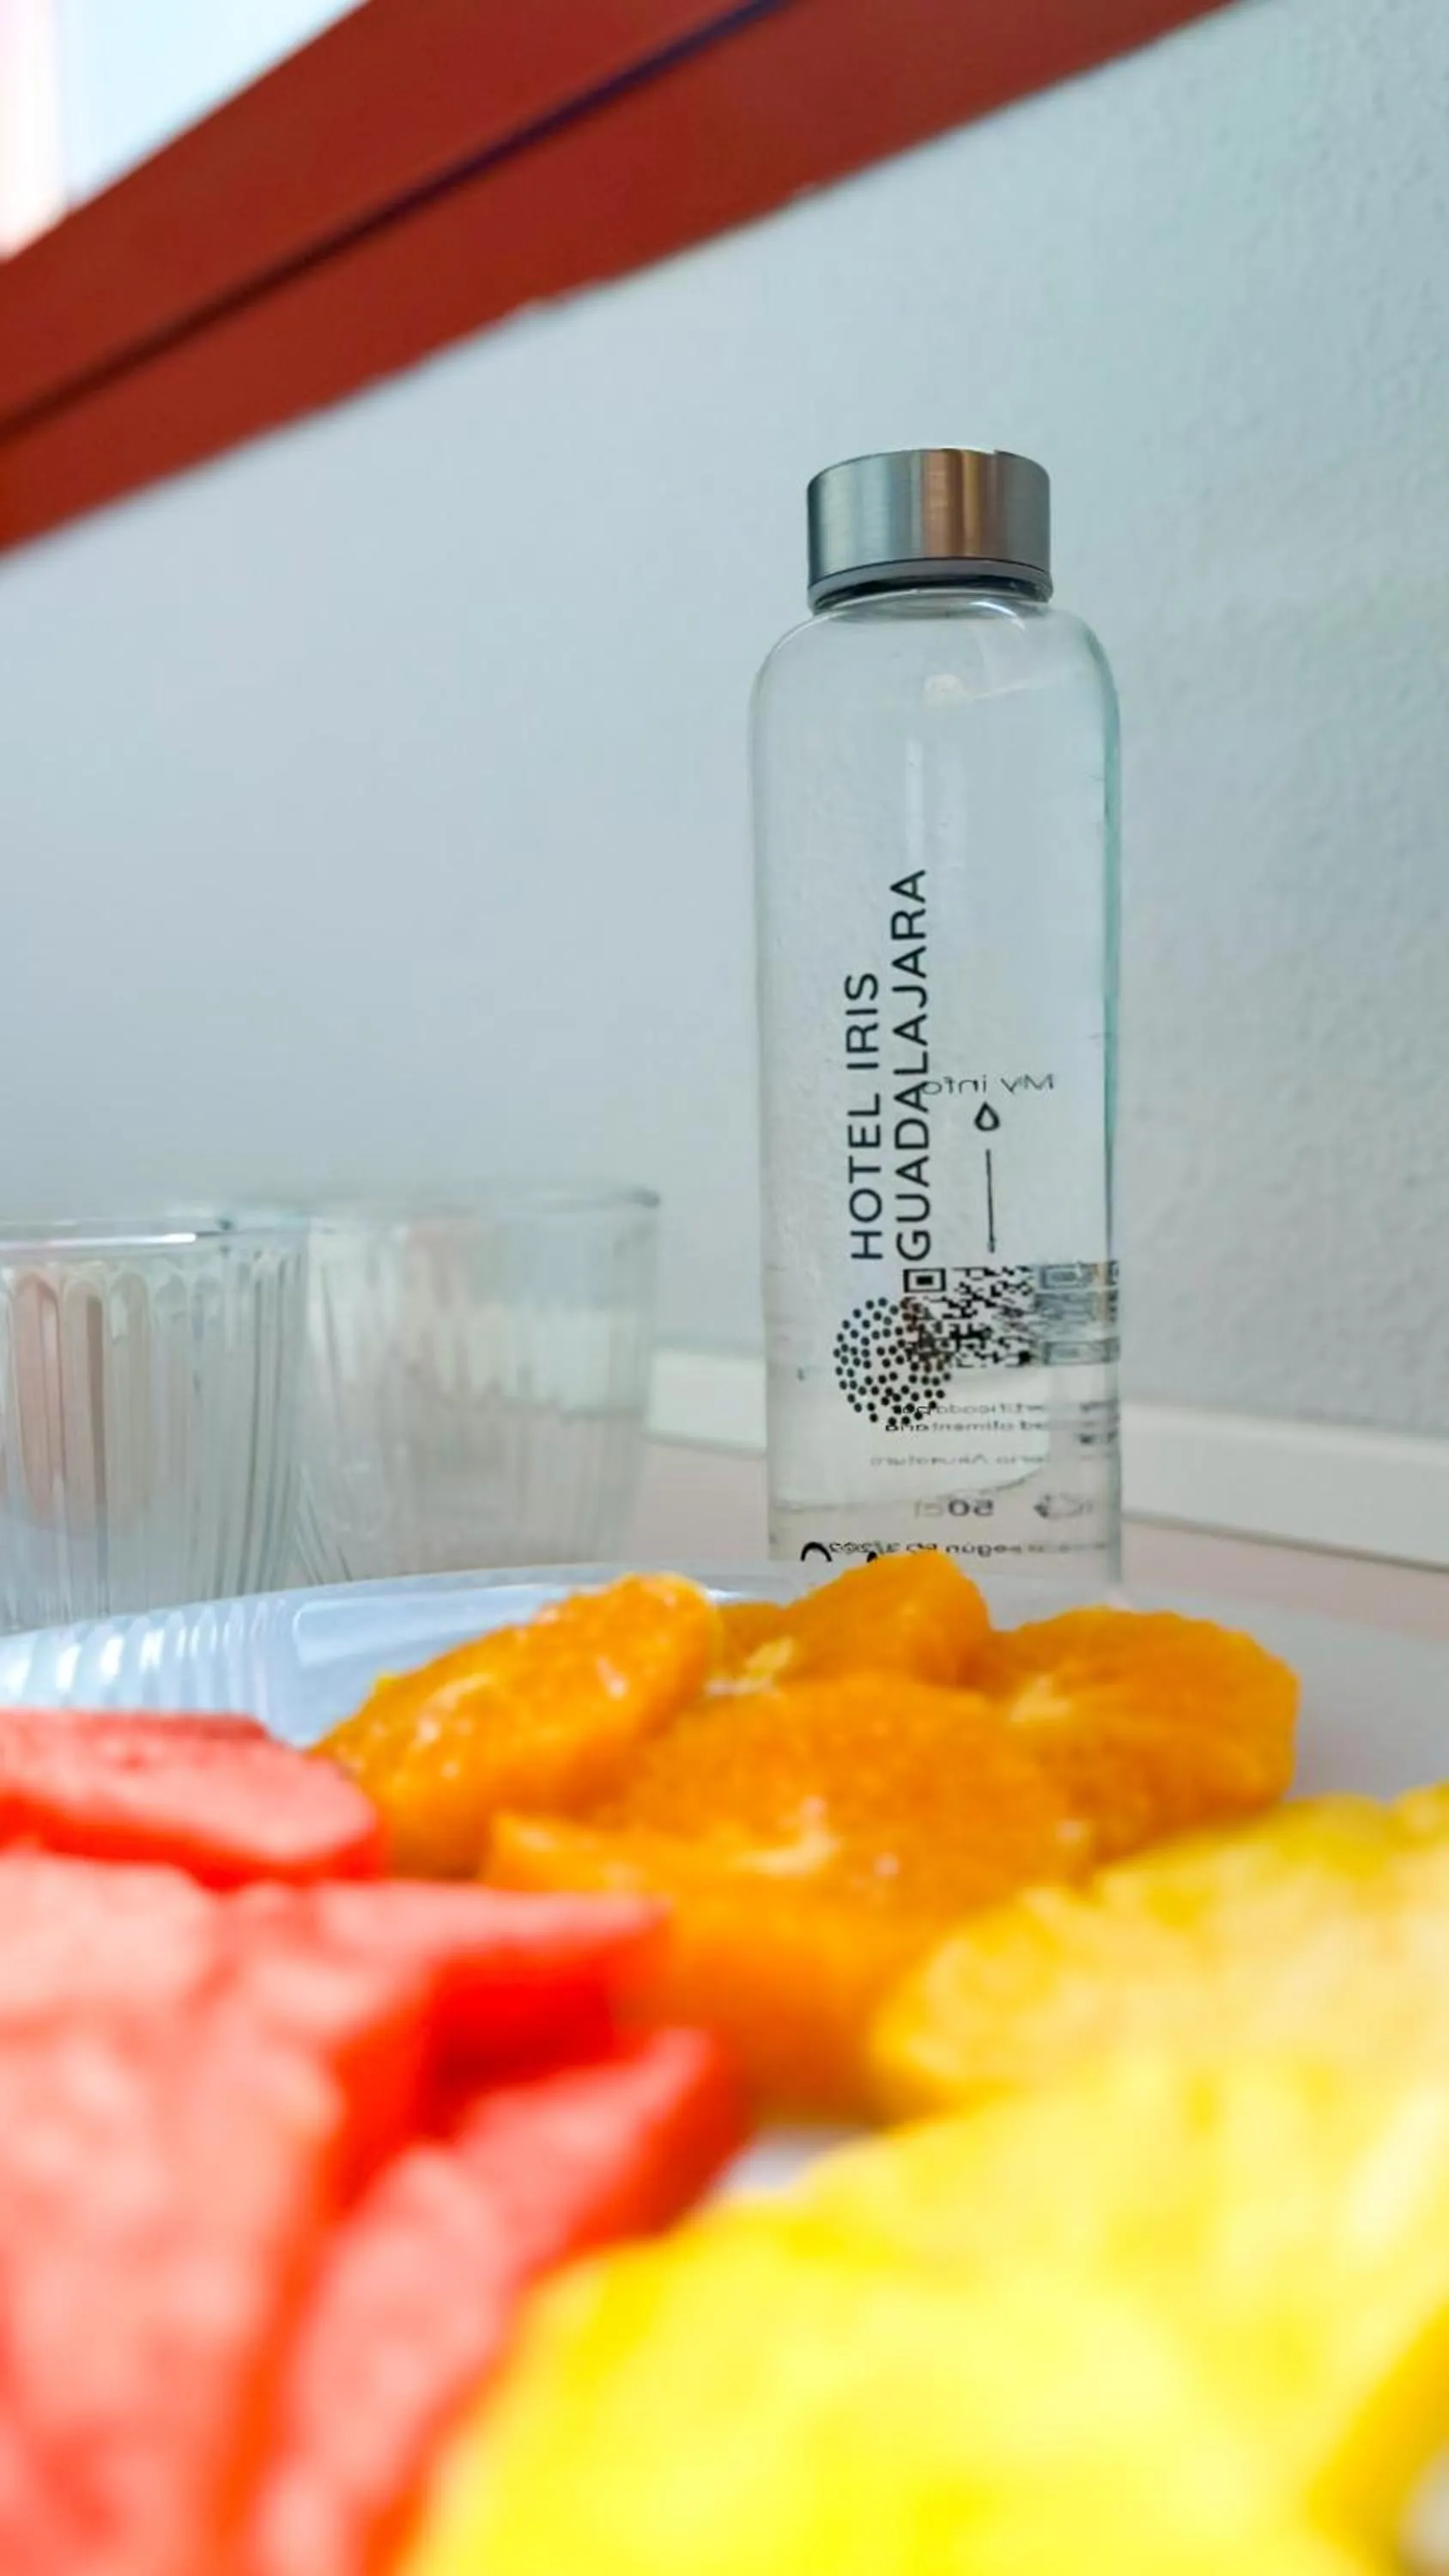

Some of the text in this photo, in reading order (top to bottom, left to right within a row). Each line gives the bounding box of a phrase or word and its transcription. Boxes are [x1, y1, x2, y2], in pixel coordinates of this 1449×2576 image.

[845, 972, 883, 1261] HOTEL IRIS
[889, 869, 931, 1261] GUADALAJARA
